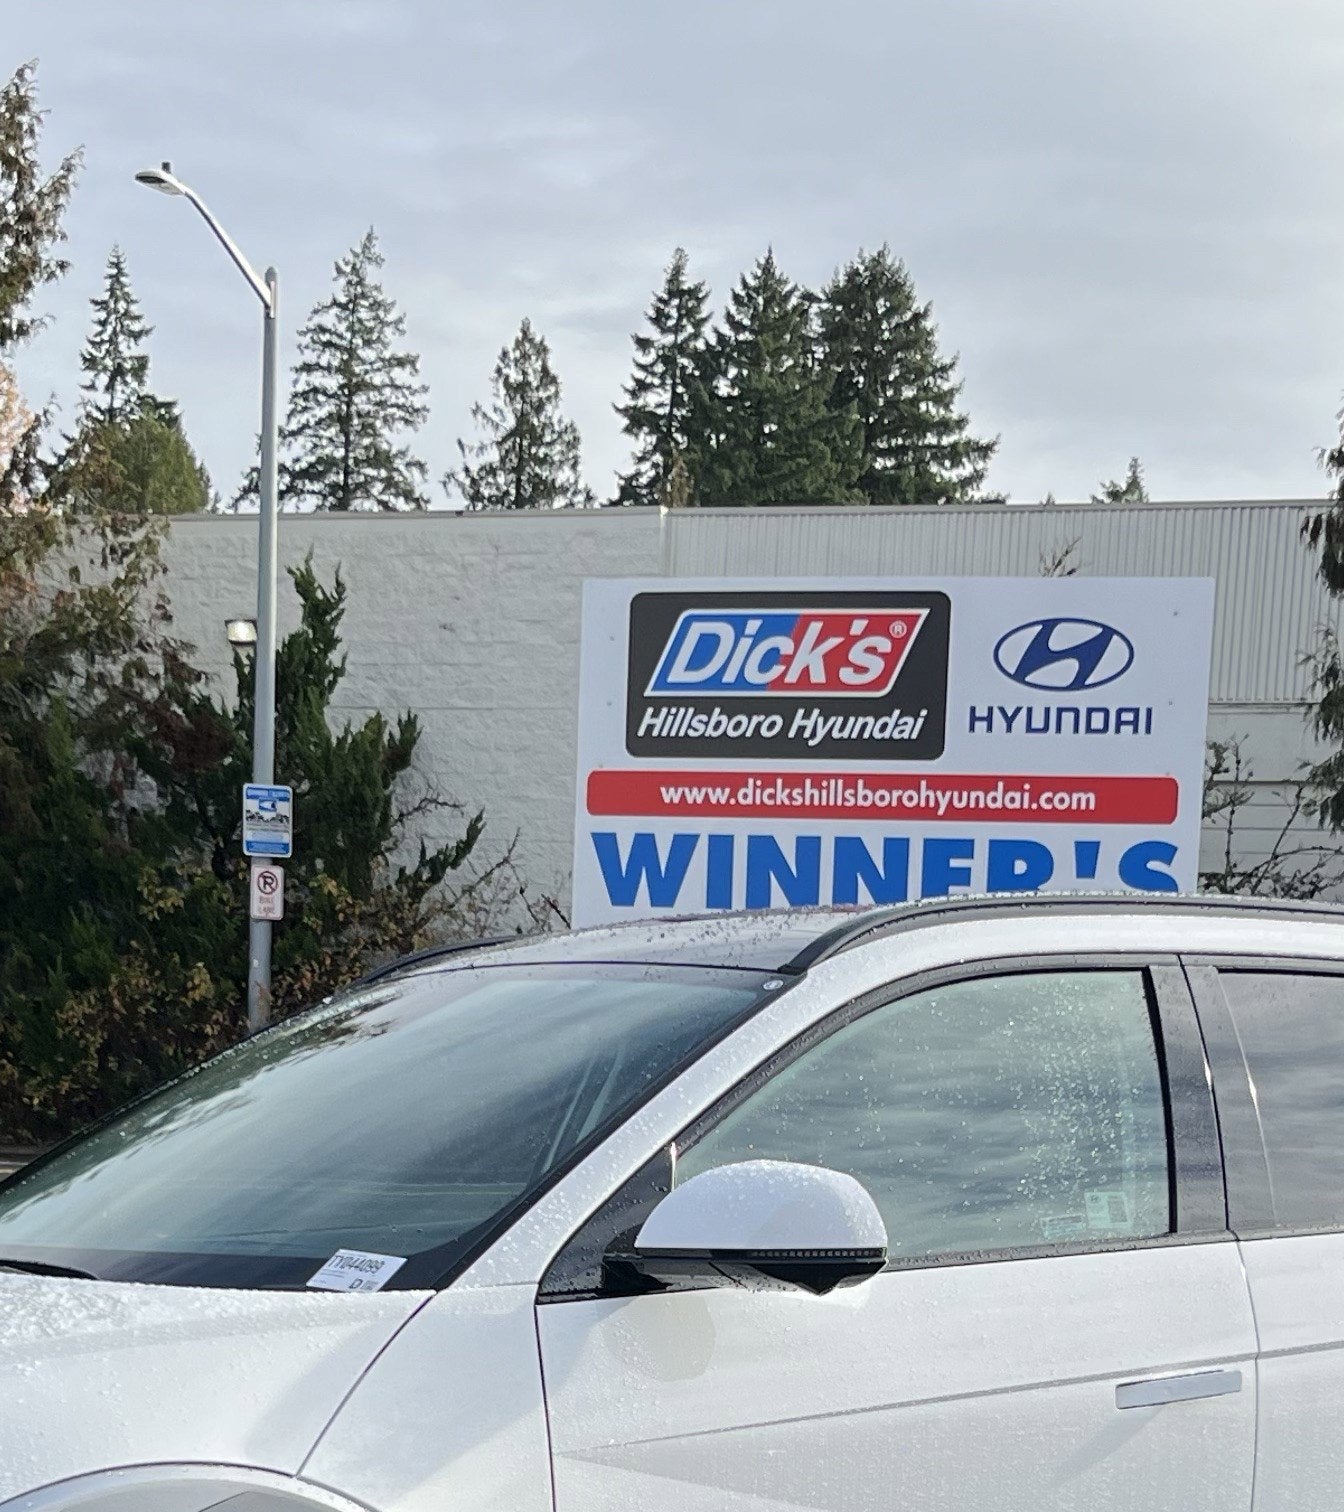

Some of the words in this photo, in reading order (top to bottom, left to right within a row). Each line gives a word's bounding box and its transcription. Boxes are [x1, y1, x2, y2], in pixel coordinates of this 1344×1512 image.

[637, 706, 783, 738] Hillsboro
[787, 708, 928, 747] Hyundai
[968, 705, 1153, 735] HYUNDAI
[659, 780, 1097, 815] www.dickshillsborohyundai.com
[590, 832, 1180, 910] WINNER'S
